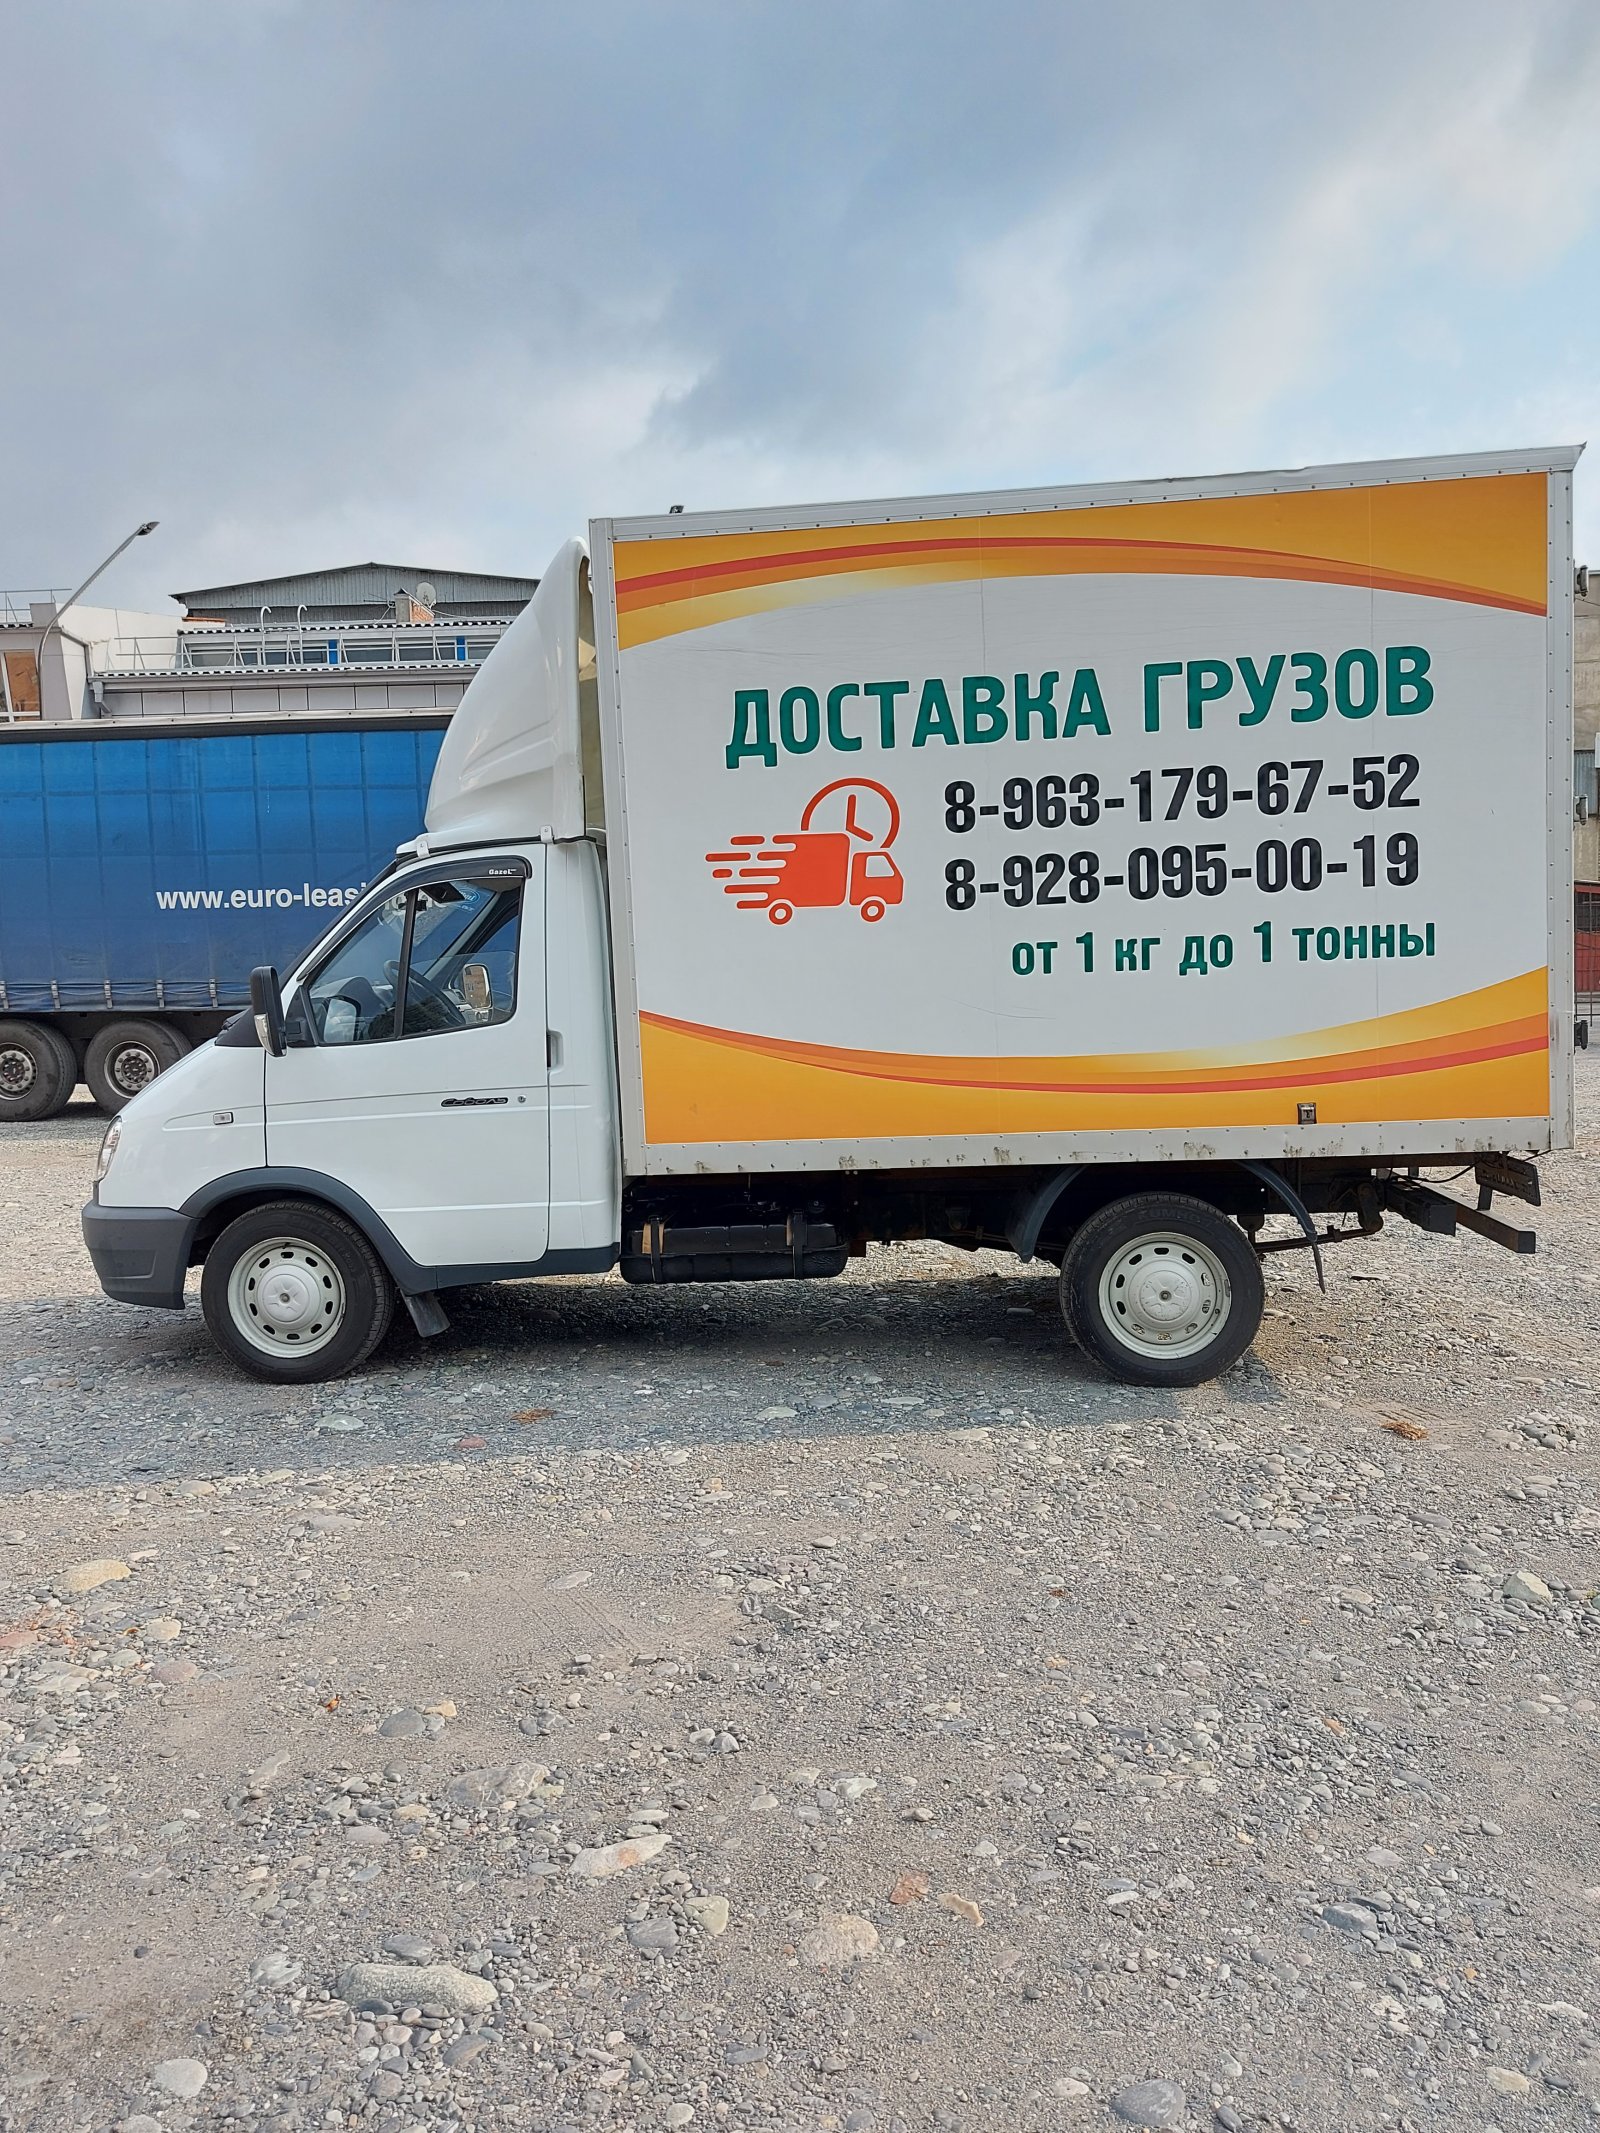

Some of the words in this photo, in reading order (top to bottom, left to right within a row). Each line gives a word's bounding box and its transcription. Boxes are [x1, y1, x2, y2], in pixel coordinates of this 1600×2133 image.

[725, 667, 1112, 770] ДОСТАВКА
[1143, 645, 1434, 733] ГРУЗОВ
[944, 753, 1420, 834] 8-963-179-67-52
[944, 832, 1419, 911] 8-928-095-00-19
[1012, 941, 1058, 976] от
[1075, 931, 1094, 973] 1
[1115, 937, 1161, 972] кг
[1178, 934, 1234, 976] до
[1253, 920, 1272, 963] 1
[1291, 922, 1436, 962] тонны
